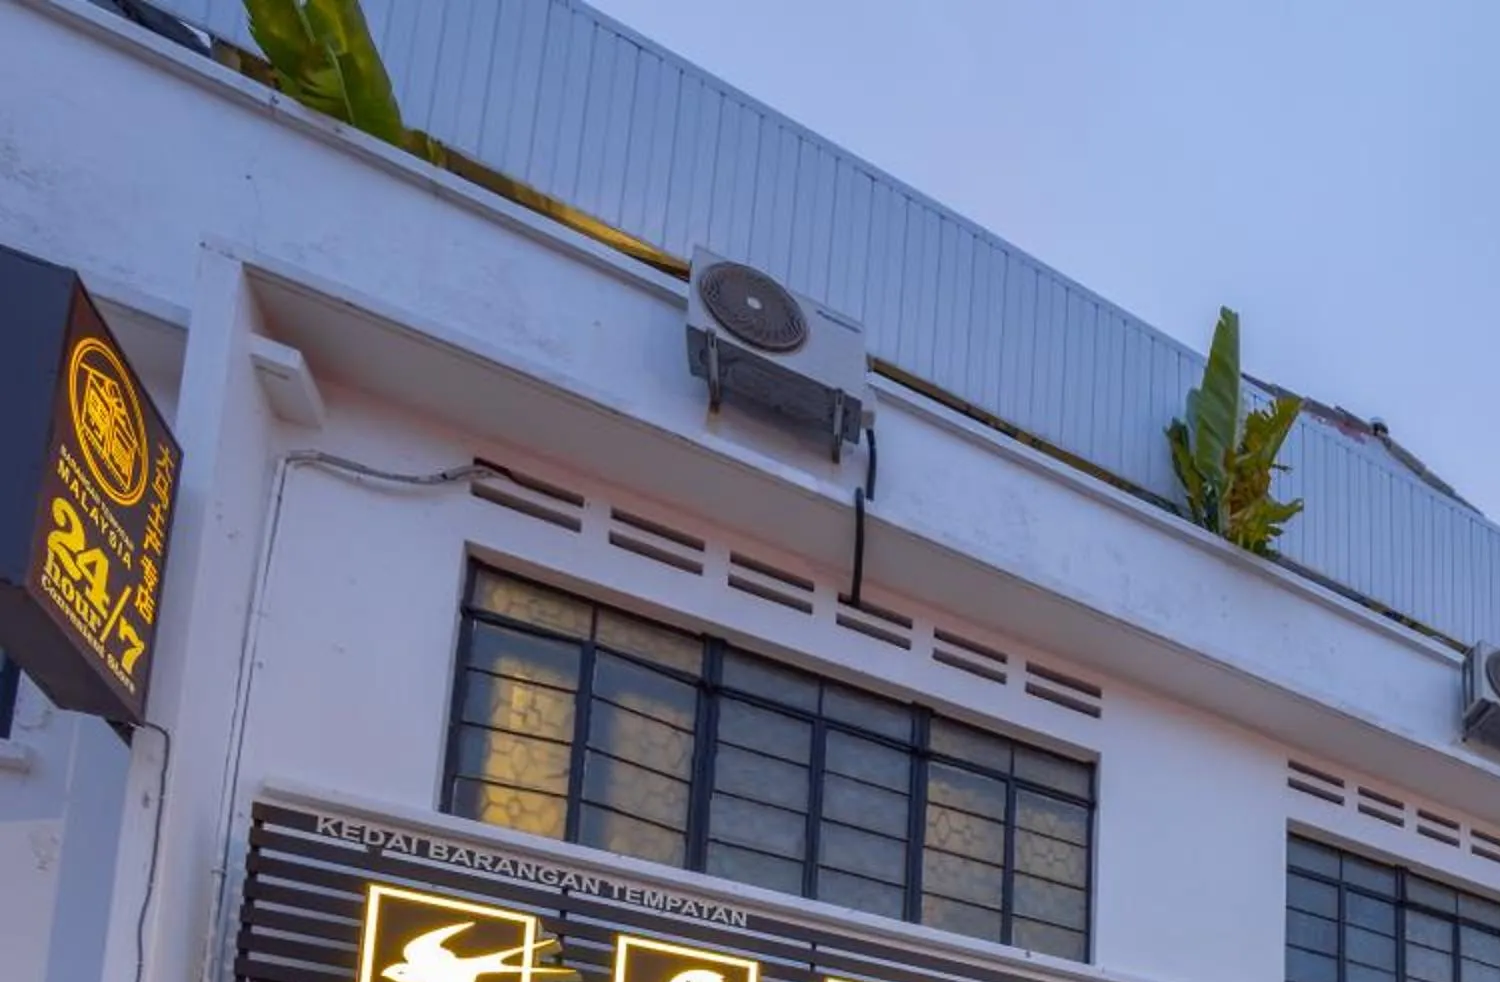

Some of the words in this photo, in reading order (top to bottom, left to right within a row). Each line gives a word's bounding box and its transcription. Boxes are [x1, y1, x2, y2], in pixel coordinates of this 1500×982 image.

[57, 458, 132, 571] MALAYSIA
[44, 549, 102, 633] hour
[316, 814, 420, 854] KEDAI
[428, 841, 601, 896] BARANGAN
[608, 883, 748, 928] TEMPATAN
